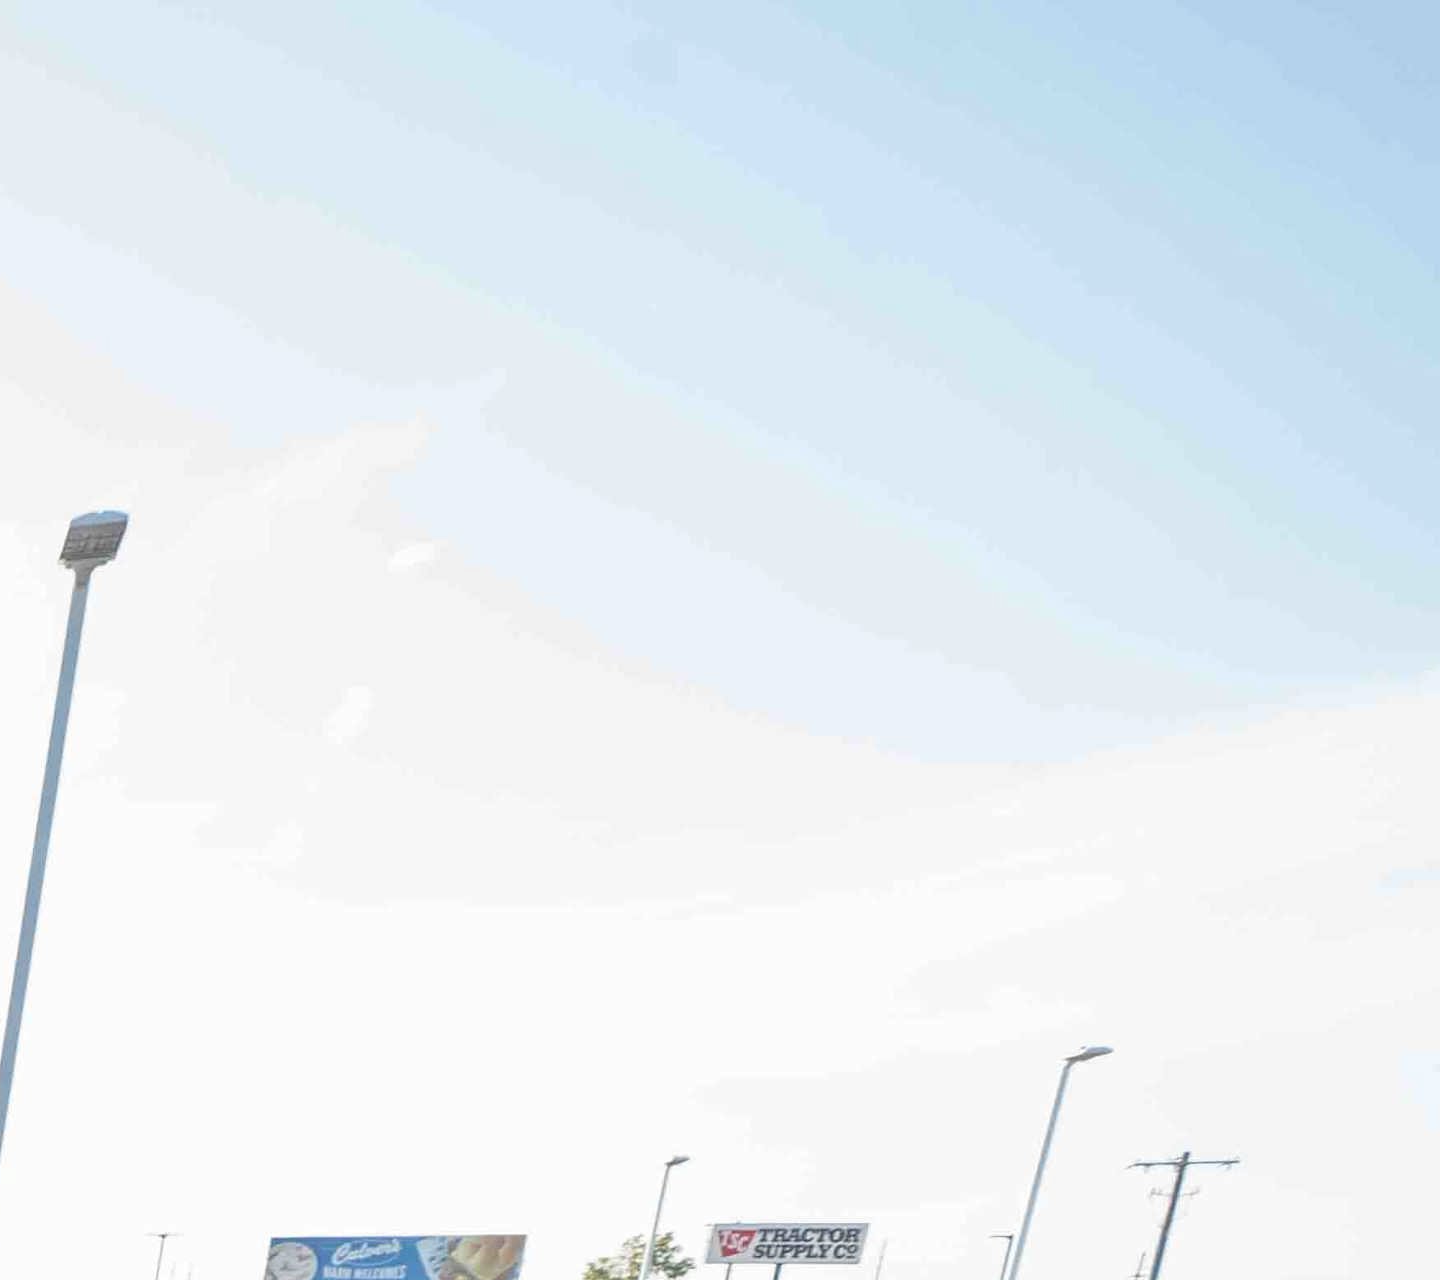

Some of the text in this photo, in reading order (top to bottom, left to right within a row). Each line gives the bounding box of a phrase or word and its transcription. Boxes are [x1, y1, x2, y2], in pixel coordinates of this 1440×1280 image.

[720, 1230, 750, 1249] TSC
[759, 1228, 861, 1243] TRACTOR
[753, 1244, 832, 1259] SUPPLY
